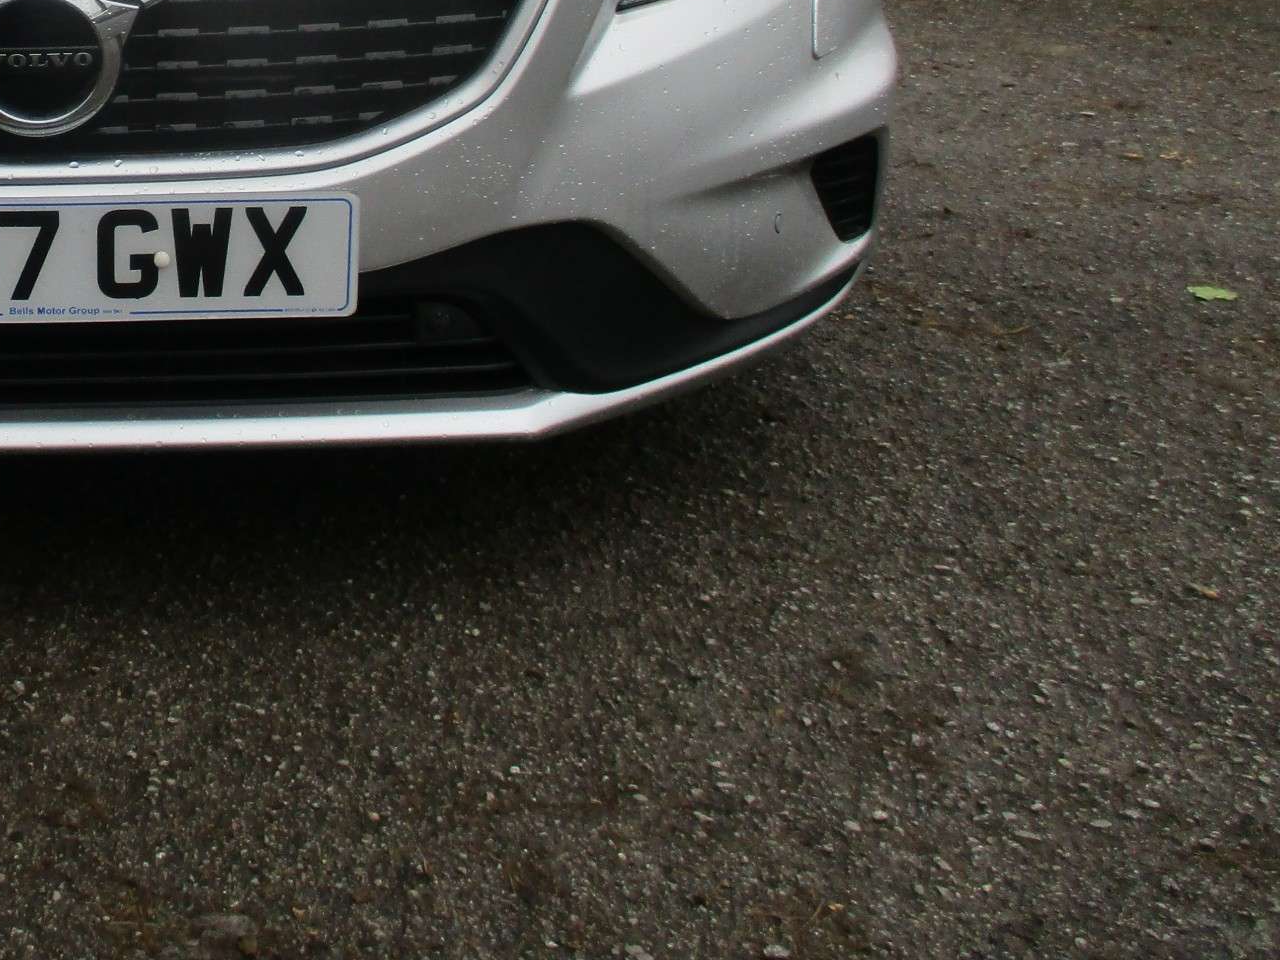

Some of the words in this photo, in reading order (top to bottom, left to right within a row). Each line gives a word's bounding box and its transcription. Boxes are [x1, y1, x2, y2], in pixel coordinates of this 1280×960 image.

[96, 206, 308, 300] GWX
[37, 307, 66, 315] Motor
[68, 306, 100, 316] Group
